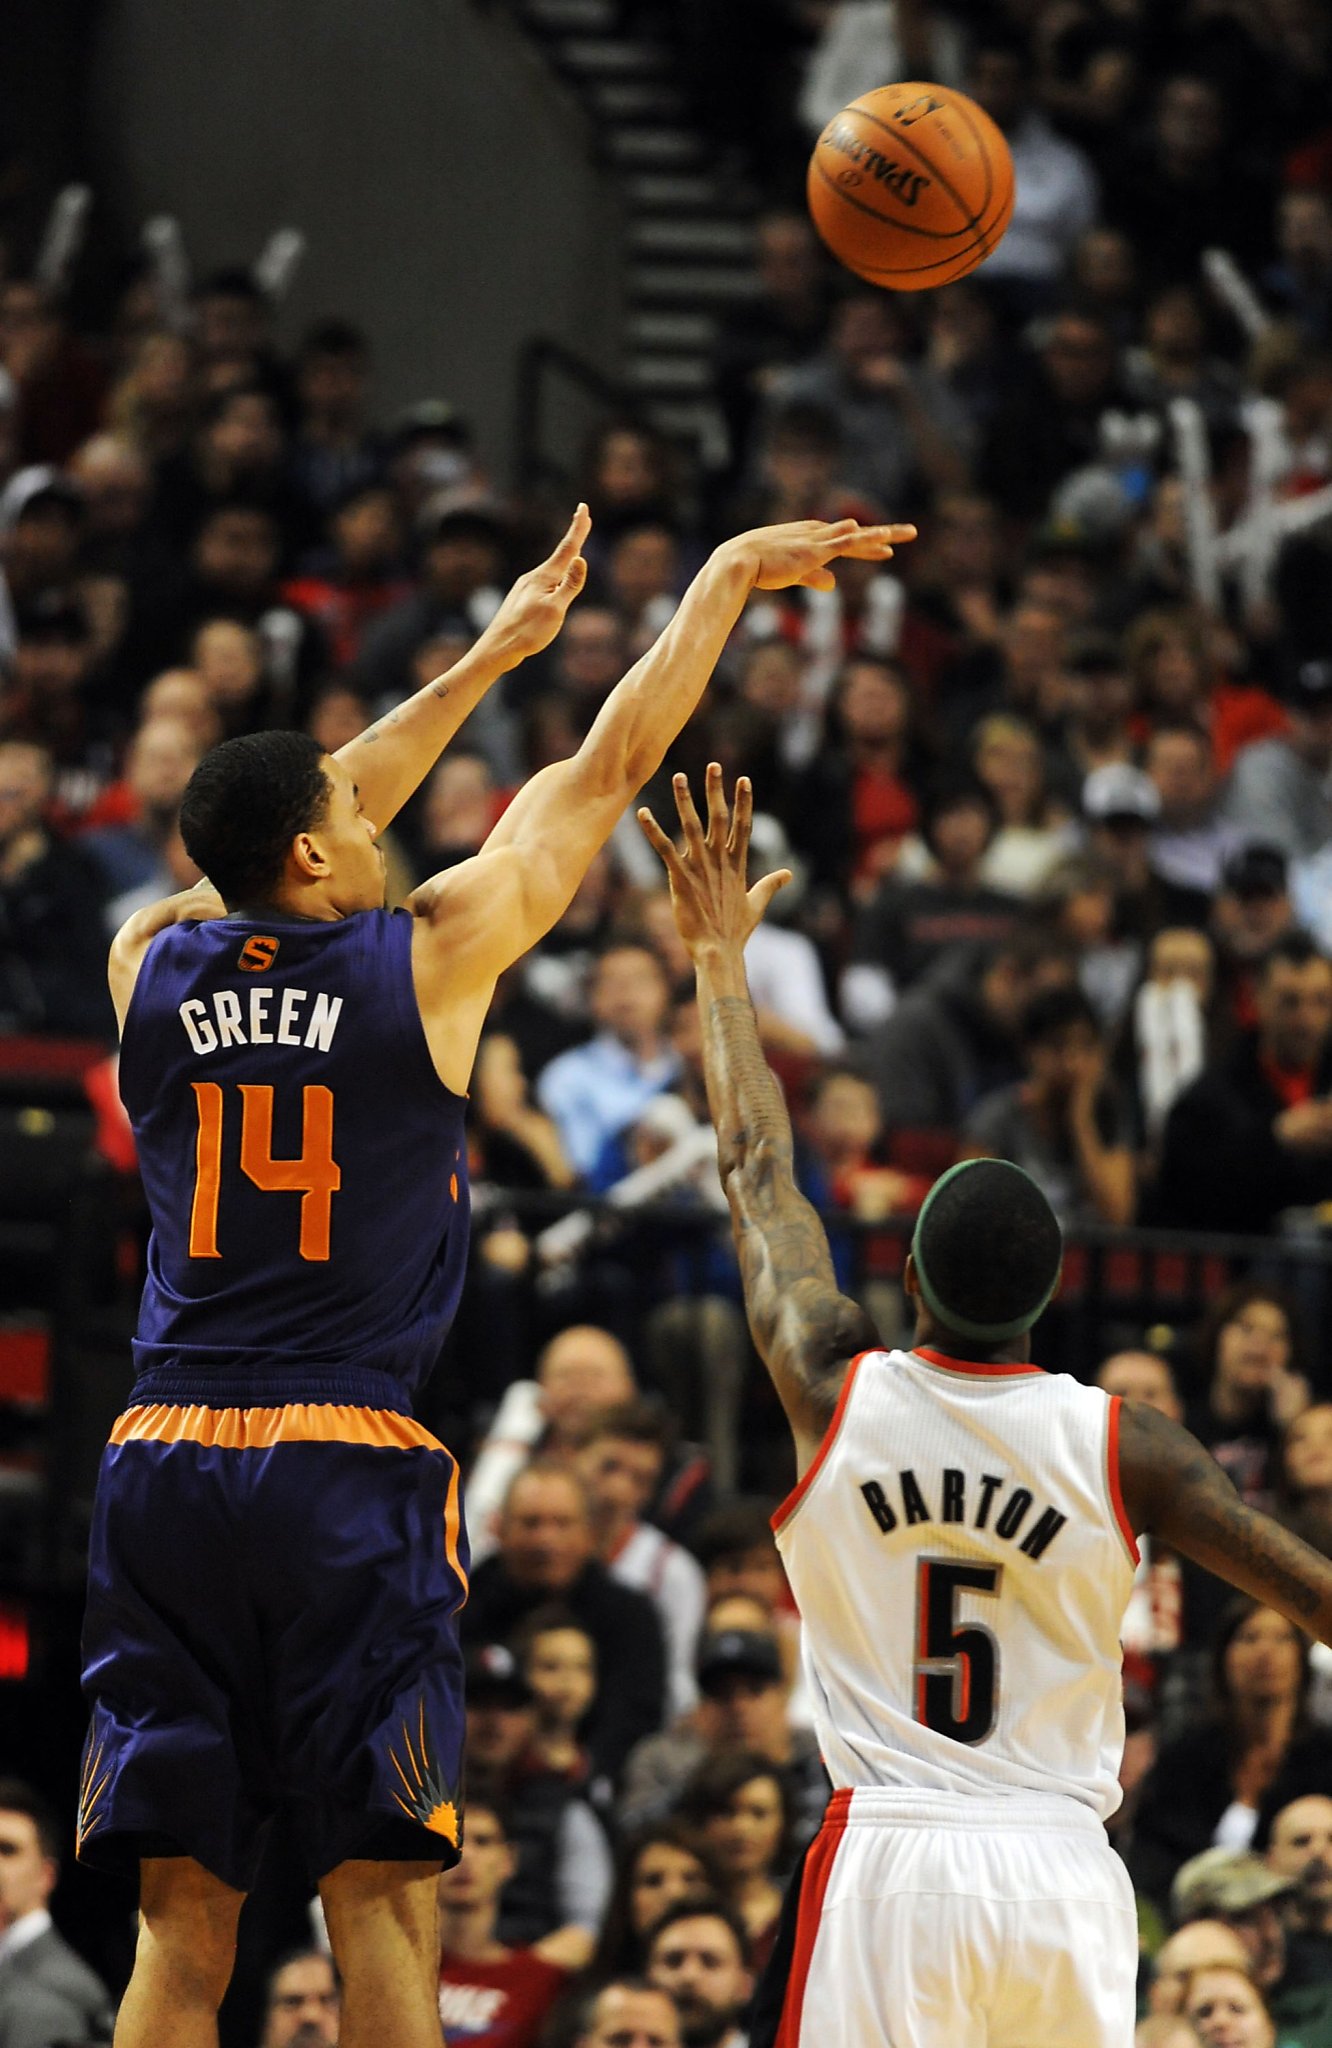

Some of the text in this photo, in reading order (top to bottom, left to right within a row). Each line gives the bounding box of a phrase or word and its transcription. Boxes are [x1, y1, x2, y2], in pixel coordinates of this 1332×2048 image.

[178, 987, 344, 1056] GREEN
[188, 1082, 341, 1261] 14
[859, 1468, 1068, 1561] BARTON
[912, 1555, 1004, 1748] 5
